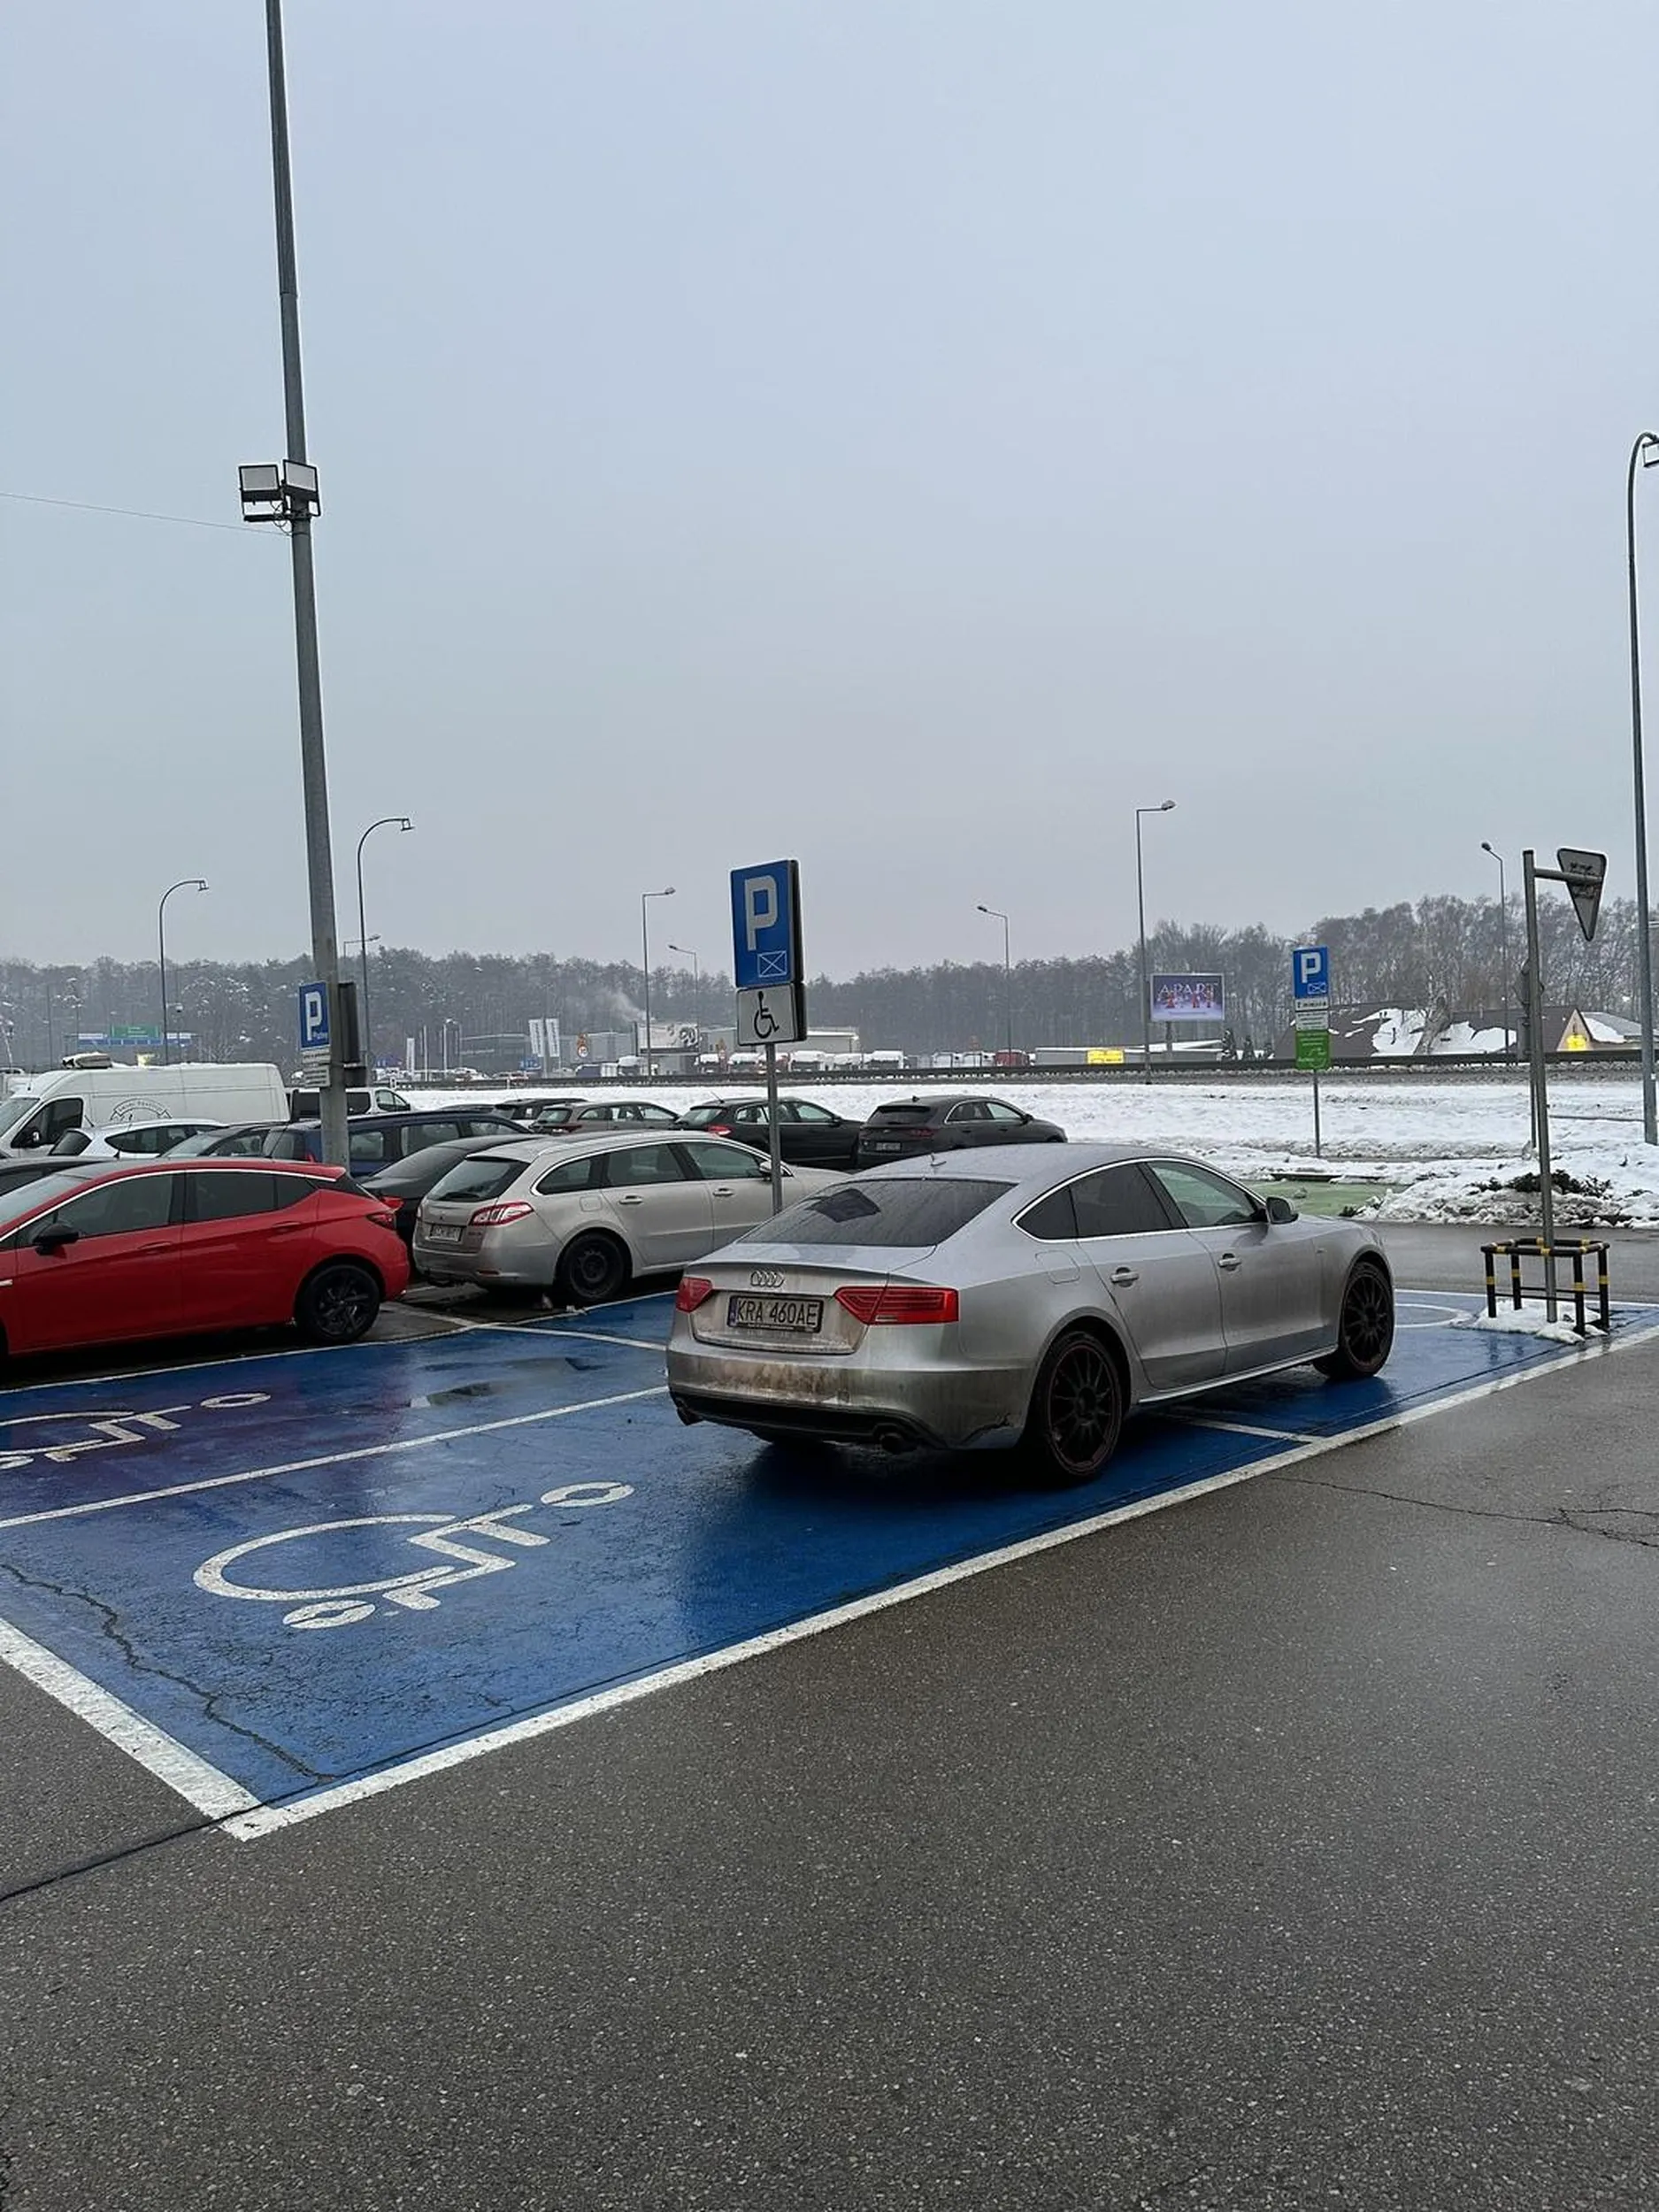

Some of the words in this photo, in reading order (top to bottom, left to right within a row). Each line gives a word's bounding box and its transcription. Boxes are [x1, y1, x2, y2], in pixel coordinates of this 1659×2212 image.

[744, 874, 779, 951] P
[1301, 951, 1322, 984] P
[304, 991, 323, 1041] P
[737, 1299, 764, 1323] KRA
[769, 1301, 818, 1325] 460AE
